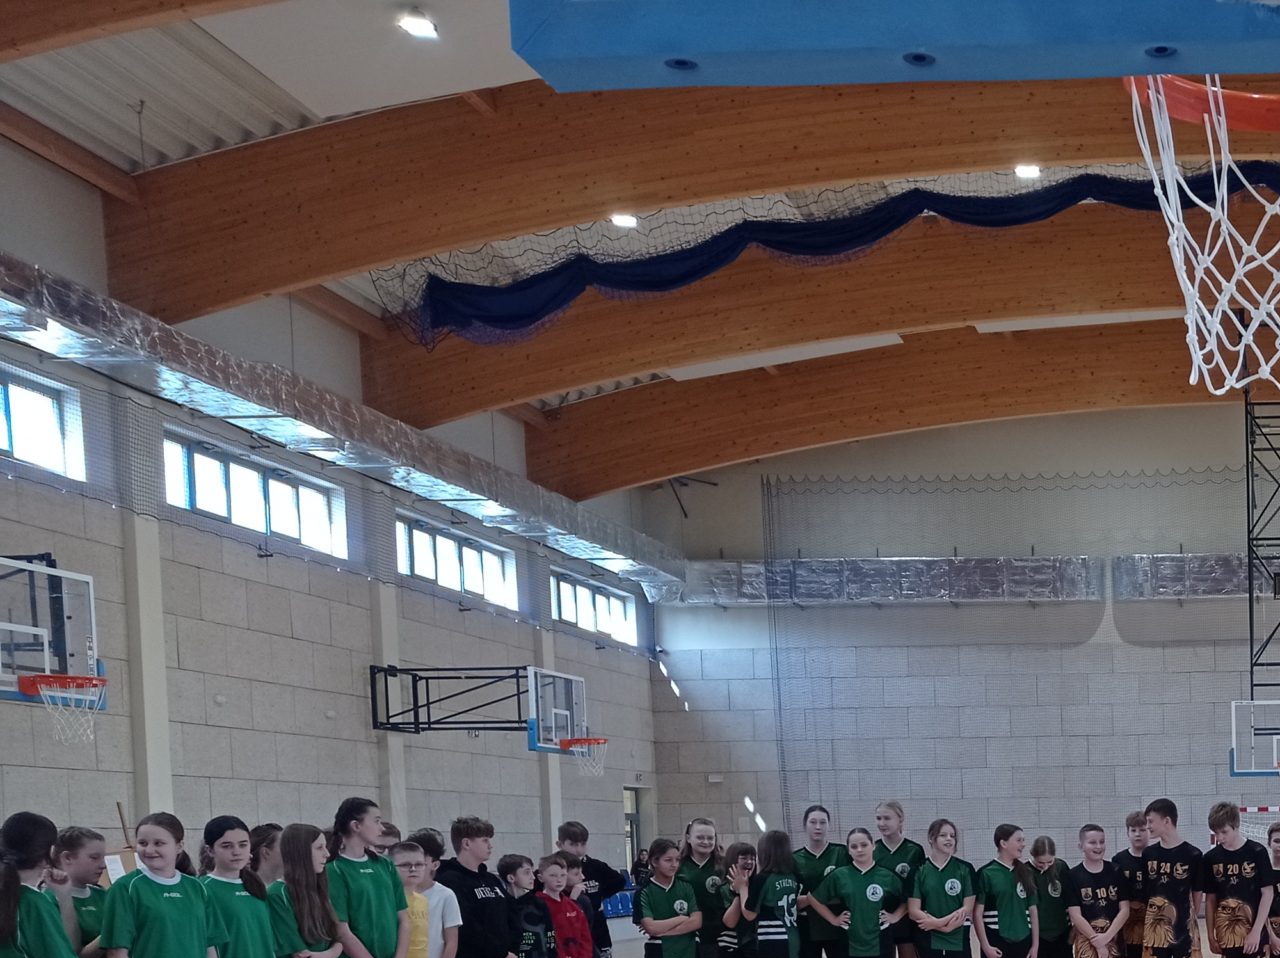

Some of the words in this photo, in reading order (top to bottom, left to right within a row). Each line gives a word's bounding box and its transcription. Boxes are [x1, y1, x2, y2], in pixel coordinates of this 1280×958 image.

[1160, 862, 1171, 873] 24
[1227, 863, 1239, 875] 20
[1136, 871, 1143, 881] 5
[1095, 887, 1107, 898] 10
